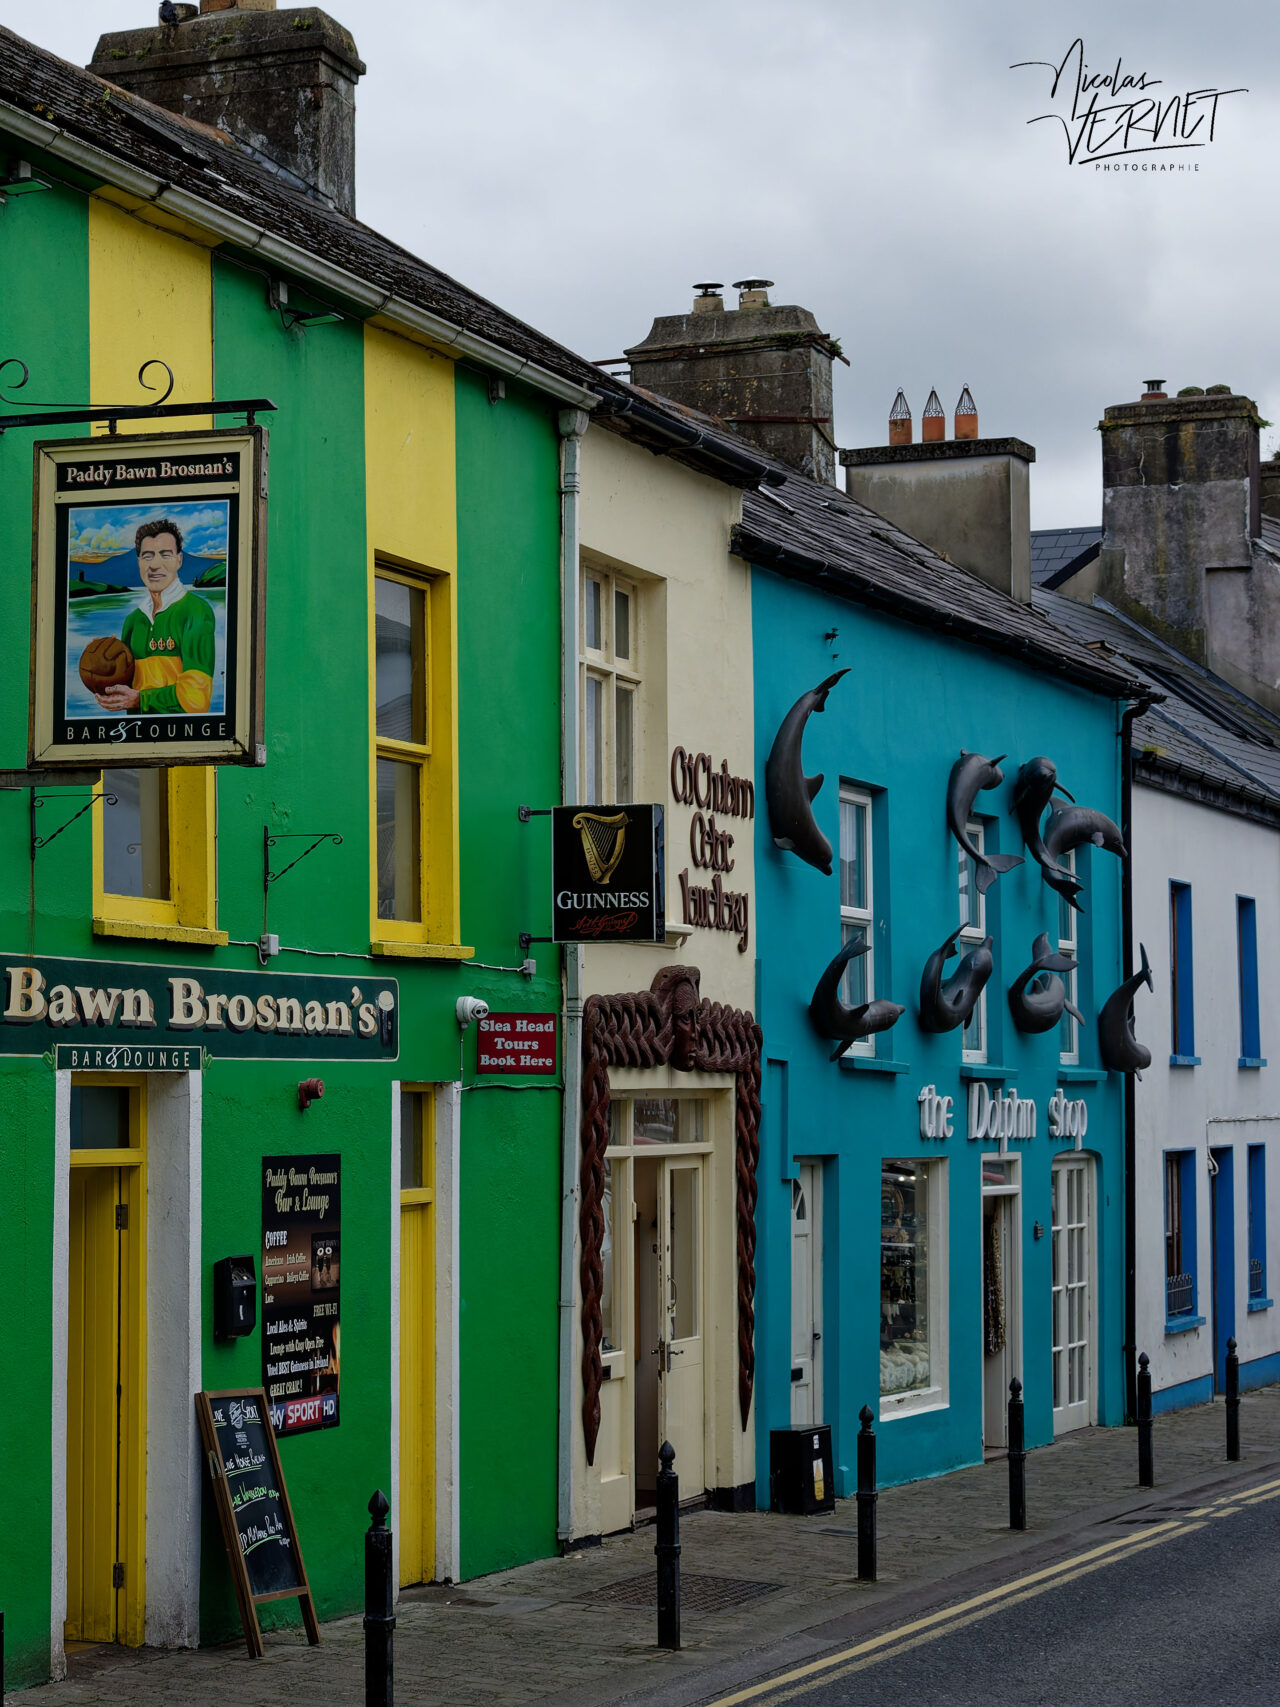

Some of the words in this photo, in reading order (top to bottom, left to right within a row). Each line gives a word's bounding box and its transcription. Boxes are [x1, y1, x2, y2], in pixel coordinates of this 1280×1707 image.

[66, 465, 113, 486] Paddy
[115, 464, 157, 480] Bawn
[160, 457, 233, 478] Brosnan's
[67, 726, 106, 740] BAR
[110, 721, 141, 743] &
[135, 722, 227, 738] LOUNGE
[557, 890, 649, 910] GUINNESS
[3, 967, 157, 1027] Bawn
[168, 977, 378, 1038] Brosnan's
[480, 1020, 511, 1032] Slea
[515, 1020, 554, 1032] Head
[494, 1037, 539, 1050] Tours
[72, 1050, 102, 1066] BAR
[105, 1047, 131, 1068] &
[123, 1051, 190, 1067] LOUNGE
[480, 1054, 516, 1066] Book
[519, 1055, 553, 1066] Here
[918, 1084, 954, 1140] the
[967, 1082, 1037, 1154] Dolphin
[265, 1168, 288, 1193] Paddy
[289, 1167, 308, 1186] Bawn
[275, 1189, 293, 1213] Bar
[294, 1195, 300, 1212] &
[301, 1187, 330, 1219] Lounge
[265, 1231, 288, 1250] COFFEE
[313, 1304, 325, 1317] FREE
[266, 1321, 278, 1335] Local
[293, 1318, 308, 1333] Spirits
[285, 1339, 295, 1353] with
[304, 1337, 315, 1352] Open
[279, 1361, 291, 1375] BEST
[290, 1360, 309, 1373] Guinness
[269, 1382, 286, 1397] GREAT
[269, 1404, 285, 1430] sky
[287, 1400, 320, 1424] SPORT
[323, 1399, 335, 1416] HD
